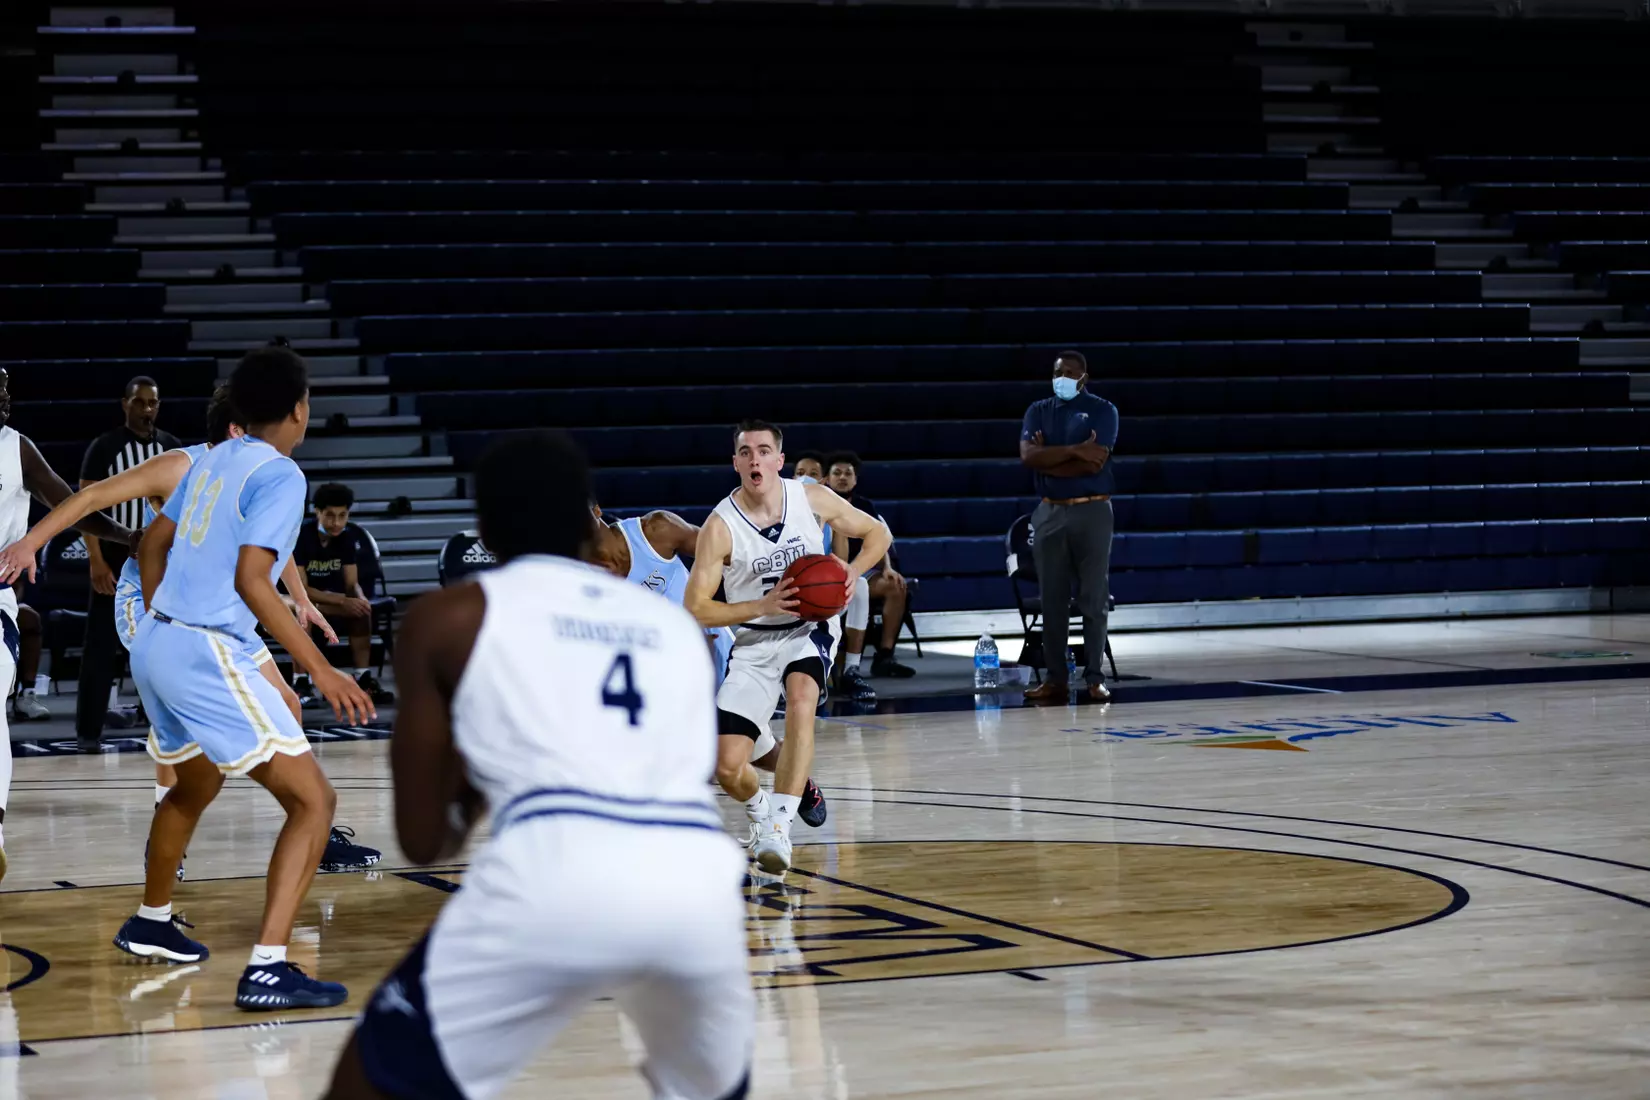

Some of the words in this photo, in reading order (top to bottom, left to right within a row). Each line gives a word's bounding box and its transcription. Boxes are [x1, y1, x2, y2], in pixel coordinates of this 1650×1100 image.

[178, 468, 223, 548] 13
[61, 551, 90, 559] adid
[462, 553, 497, 563] adida
[601, 652, 643, 727] 4
